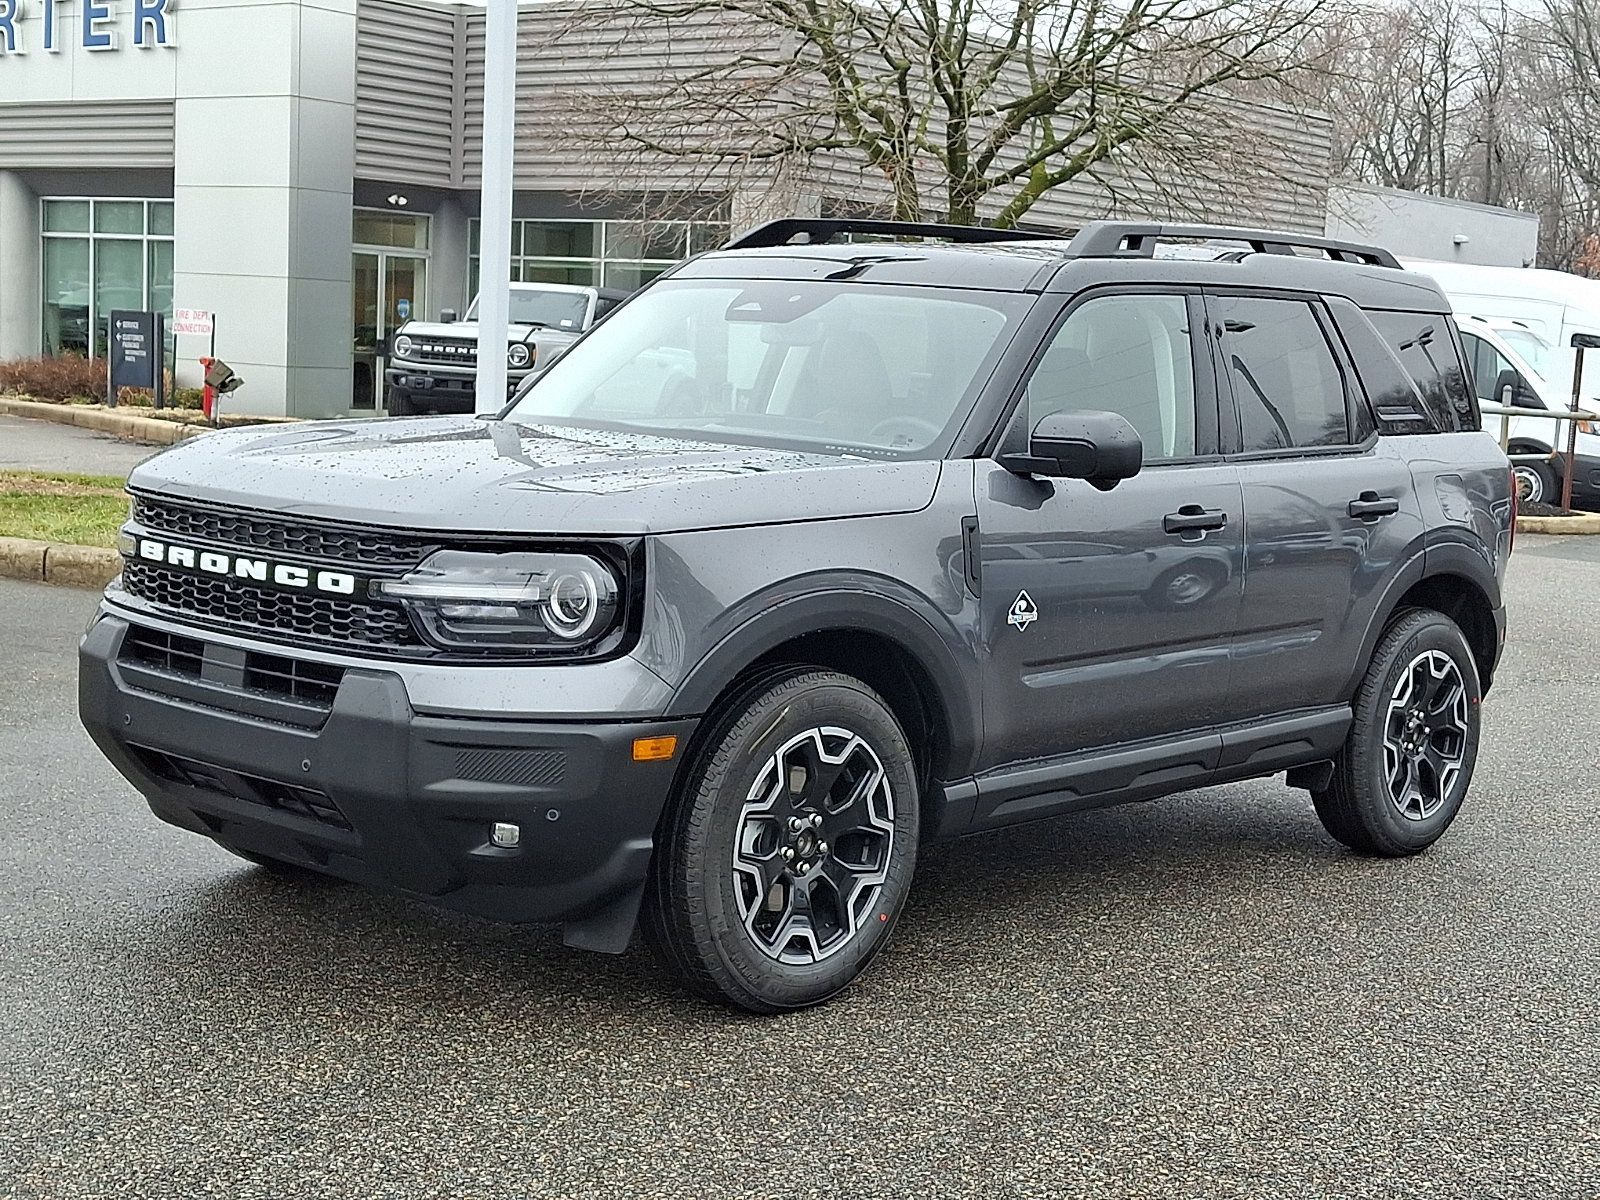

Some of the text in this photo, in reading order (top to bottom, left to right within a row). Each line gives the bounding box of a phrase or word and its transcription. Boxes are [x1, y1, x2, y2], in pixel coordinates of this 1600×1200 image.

[175, 309, 190, 320] FIRE
[173, 322, 211, 333] CONNECTION
[140, 539, 355, 595] BRONCO
